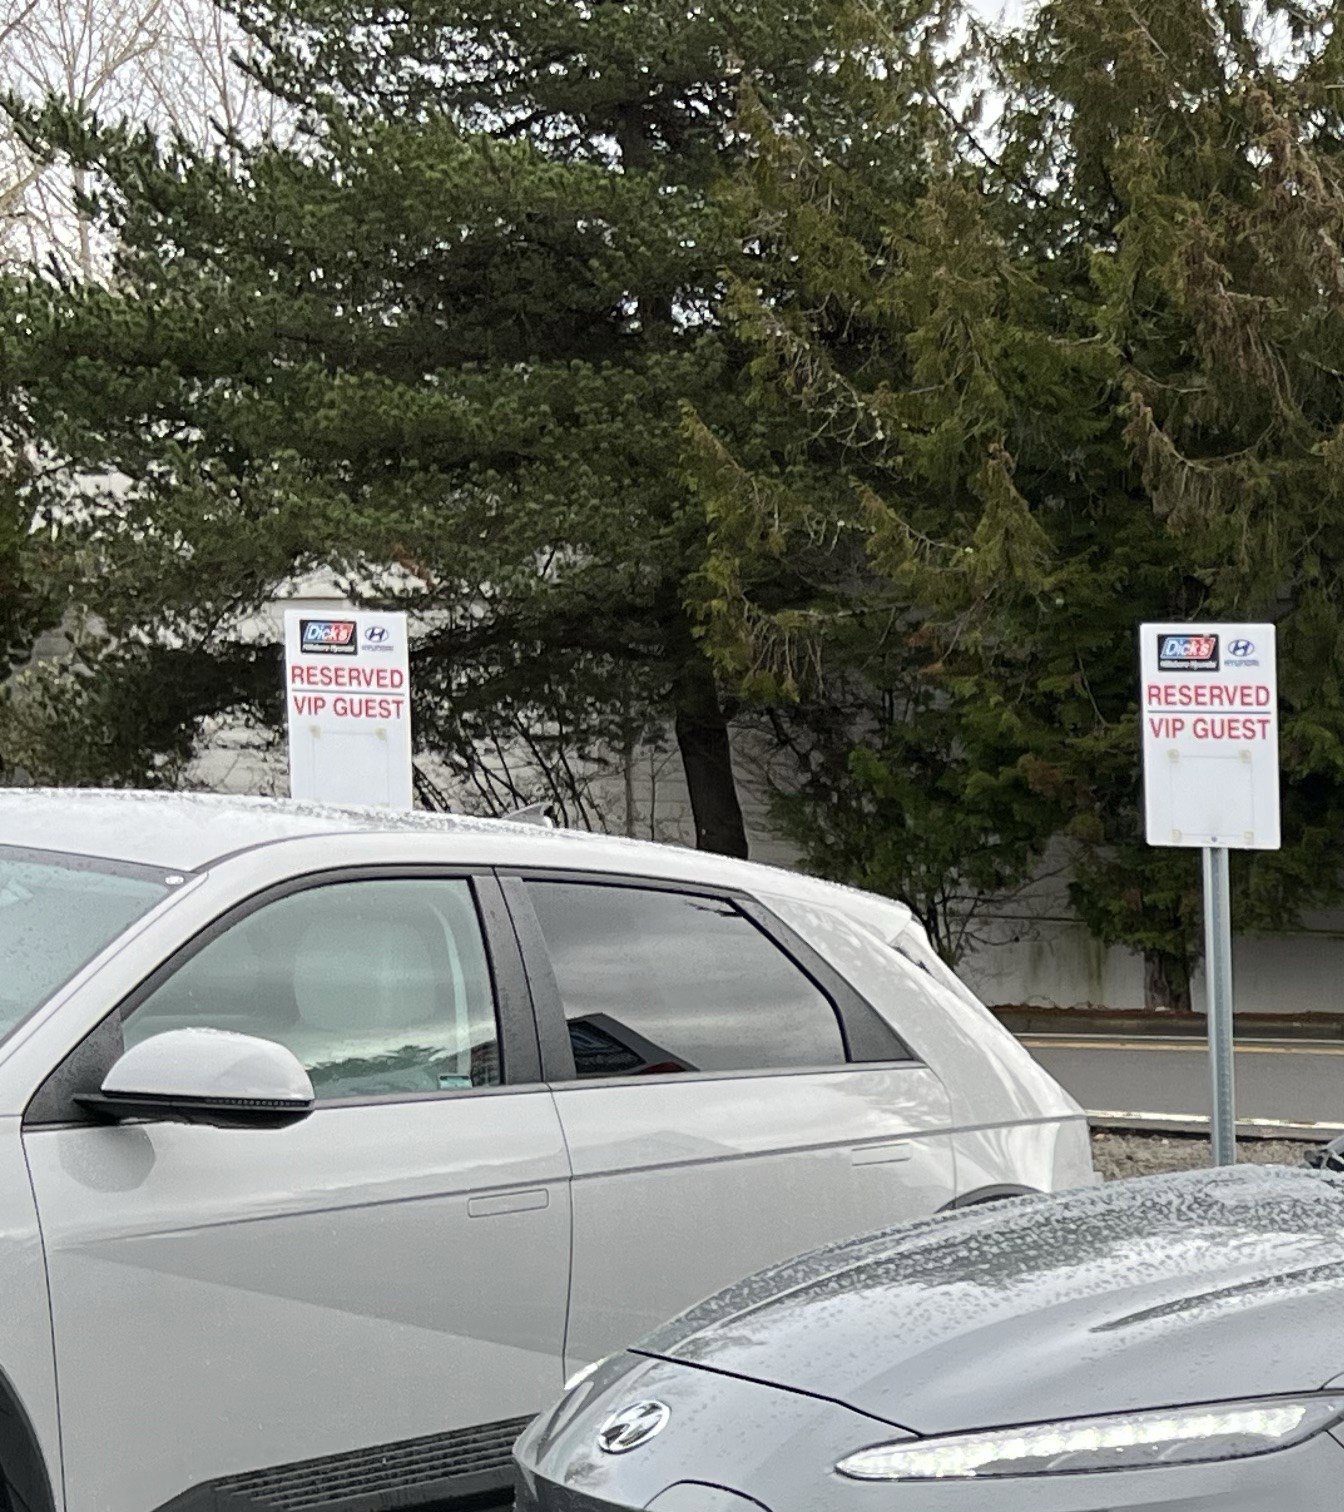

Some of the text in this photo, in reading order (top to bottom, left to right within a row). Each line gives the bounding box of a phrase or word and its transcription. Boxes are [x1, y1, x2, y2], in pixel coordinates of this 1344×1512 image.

[291, 665, 404, 689] RESERVED
[293, 695, 404, 719] VIP GUEST
[1147, 684, 1271, 707] RESERVED
[1149, 718, 1271, 740] VIP GUEST
